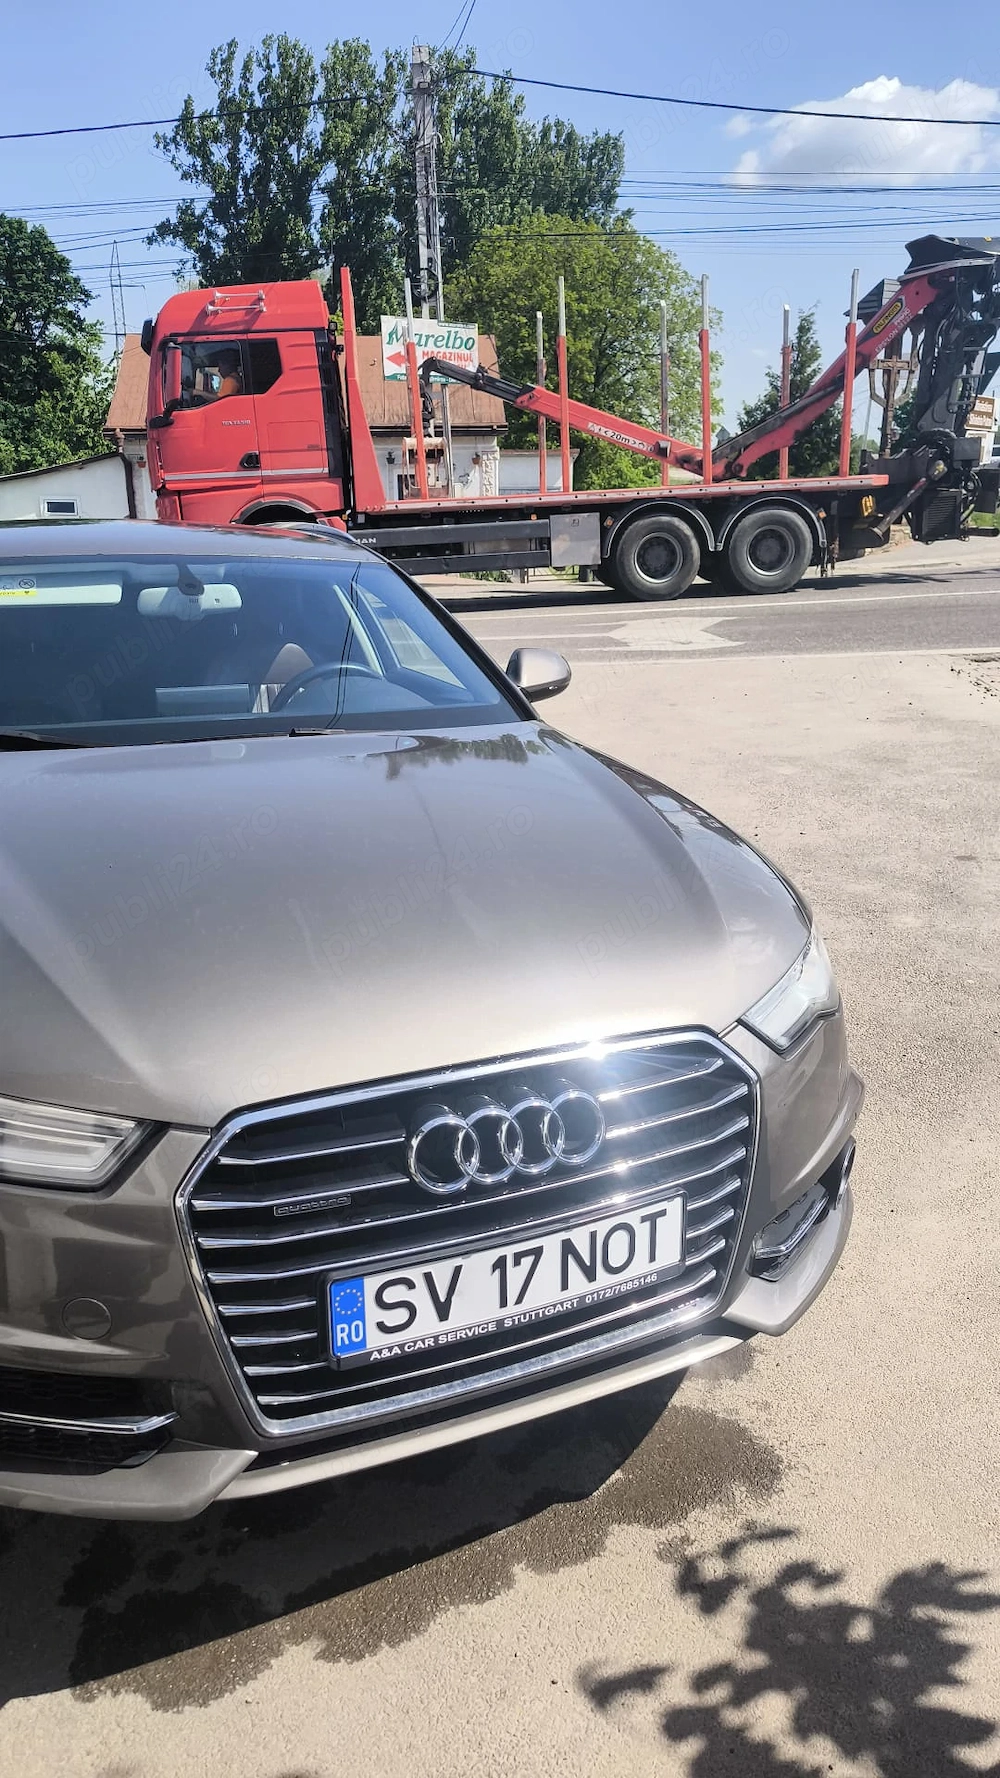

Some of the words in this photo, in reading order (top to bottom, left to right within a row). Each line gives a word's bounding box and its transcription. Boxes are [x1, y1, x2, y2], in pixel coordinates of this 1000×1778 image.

[421, 350, 474, 363] MAGAZINUL
[610, 431, 631, 444] 20m
[277, 1196, 348, 1215] quattro
[374, 1264, 464, 1335] SV
[491, 1245, 544, 1309] 17
[561, 1208, 667, 1292] NOT
[369, 1347, 402, 1362] A&A
[404, 1337, 435, 1353] CAR
[438, 1321, 497, 1345] SERVICE
[503, 1298, 580, 1328] STUTTGART
[585, 1273, 658, 1304] 0172/7685146
[336, 1320, 364, 1347] RO
